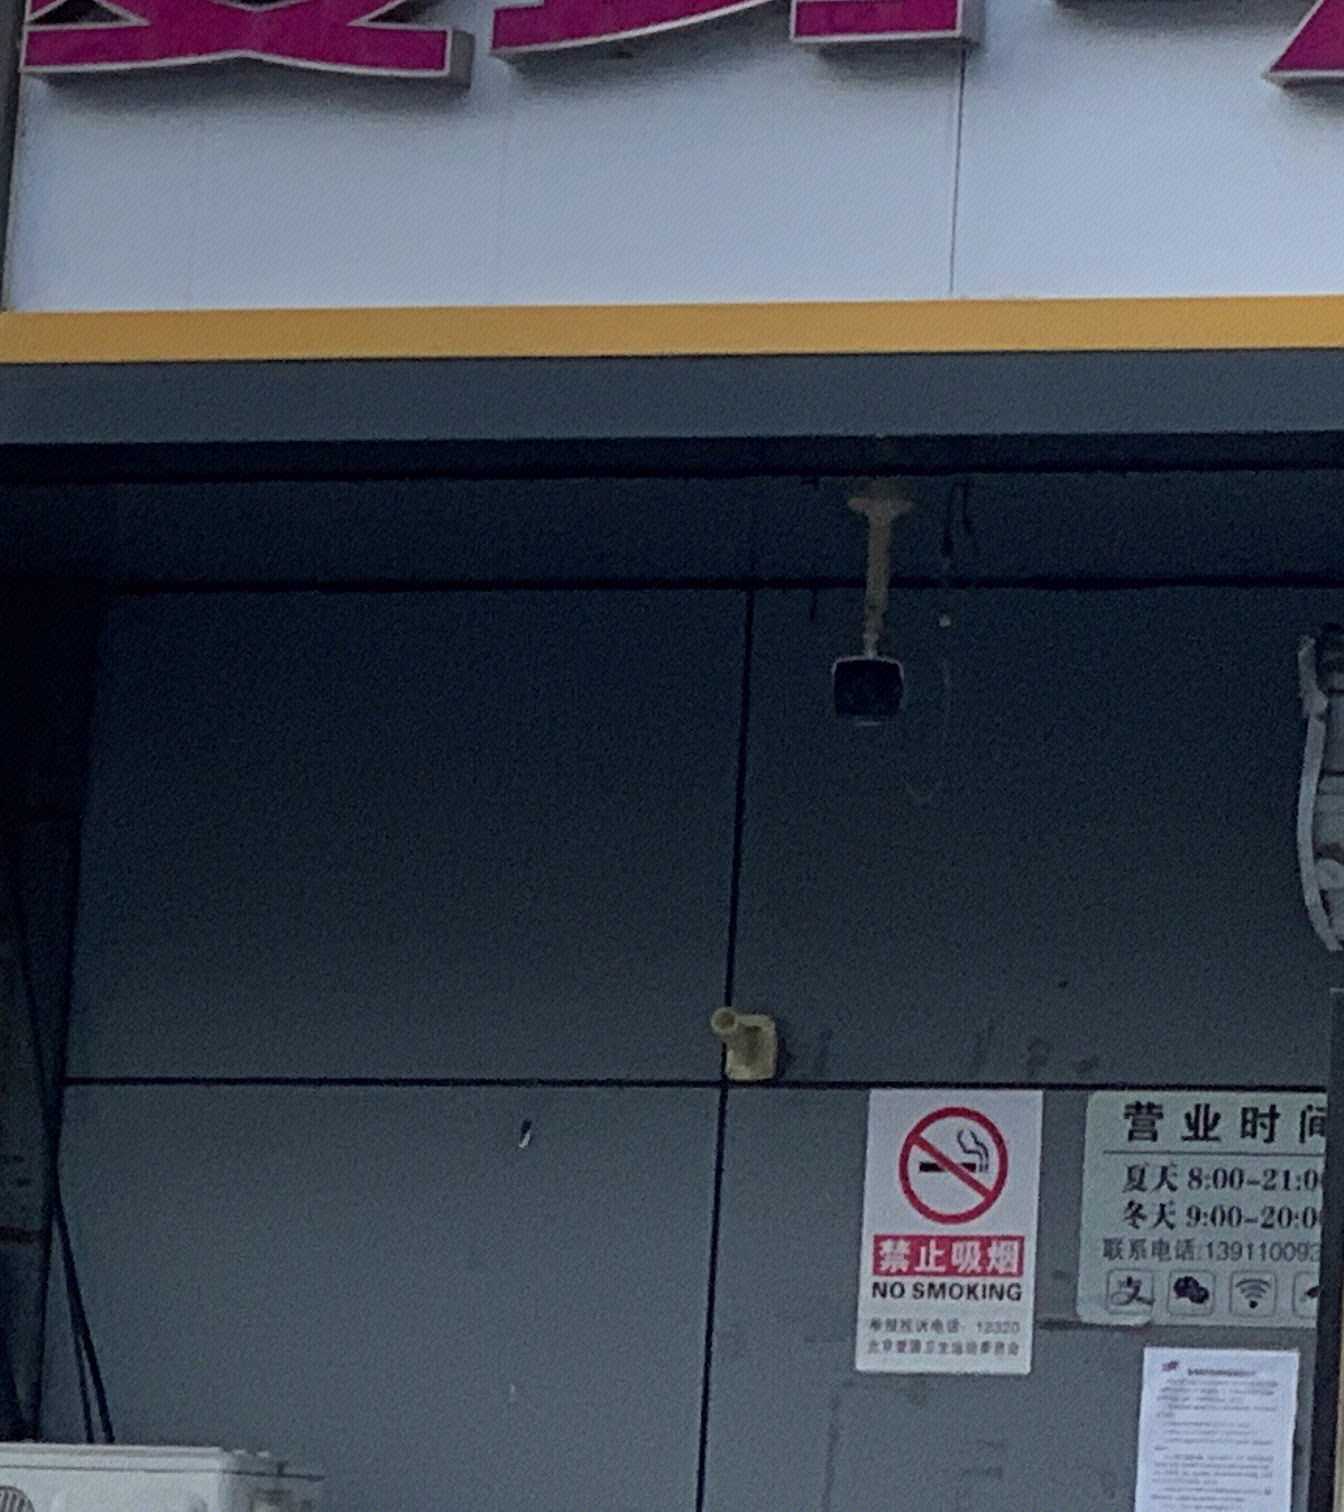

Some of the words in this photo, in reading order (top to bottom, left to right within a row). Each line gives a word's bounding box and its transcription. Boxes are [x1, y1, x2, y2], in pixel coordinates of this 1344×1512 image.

[1123, 1100, 1326, 1144] 营业时间
[1122, 1161, 1178, 1193] 夏天
[1187, 1167, 1324, 1192] 8:00-21:0
[1123, 1199, 1176, 1230] 冬天
[1186, 1205, 1322, 1230] 9:00-20:0
[878, 1238, 1020, 1274] 禁止吸烟
[872, 1281, 906, 1300] NO
[911, 1281, 1022, 1302] SMOKING
